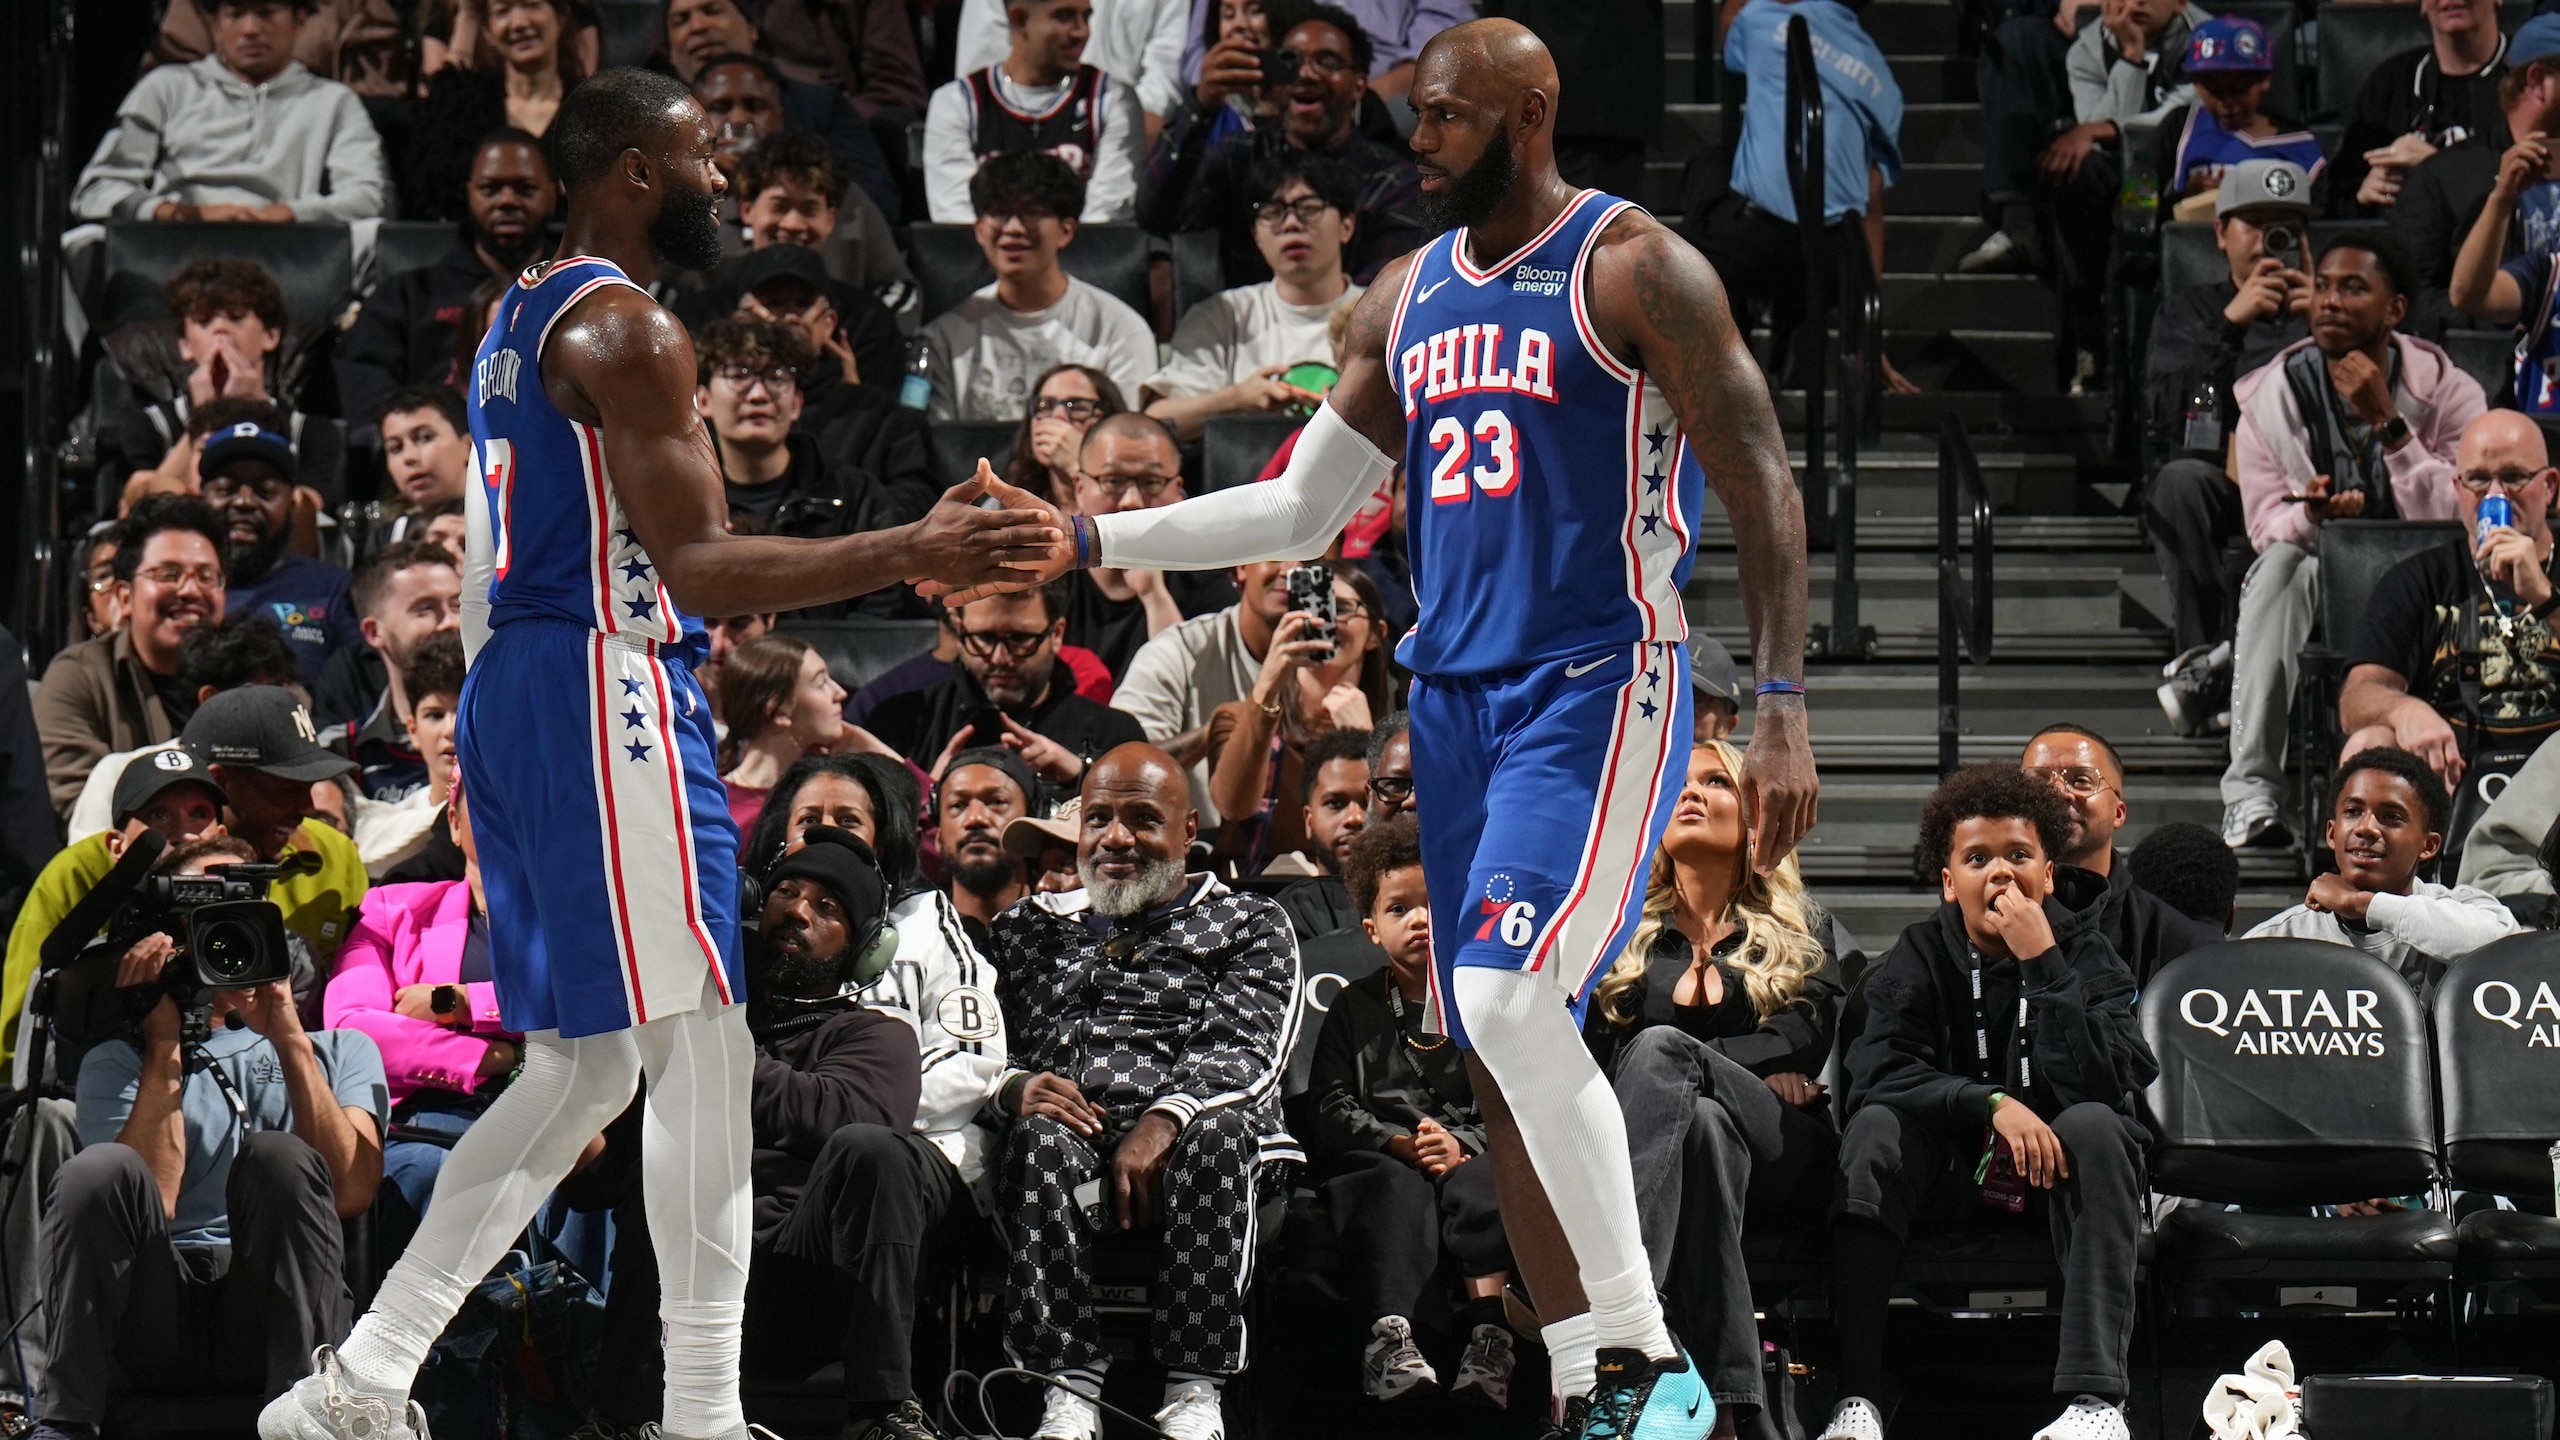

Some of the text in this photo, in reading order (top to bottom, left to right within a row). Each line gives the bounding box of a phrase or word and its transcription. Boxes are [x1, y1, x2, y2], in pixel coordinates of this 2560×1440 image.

[1513, 280, 1564, 296] energy
[1516, 265, 1567, 282] Bloom
[477, 348, 522, 409] BROWN
[1401, 323, 1559, 422] PHILA
[1429, 409, 1520, 505] 23
[486, 438, 516, 582] 7
[167, 752, 181, 767] B
[1474, 895, 1536, 947] 76
[961, 995, 982, 1030] B
[2179, 988, 2384, 1037] QATAR
[2234, 1031, 2385, 1056] AIRWAYS
[1101, 1288, 1135, 1299] WC
[2003, 1295, 2012, 1304] 3
[2313, 1291, 2323, 1300] 4
